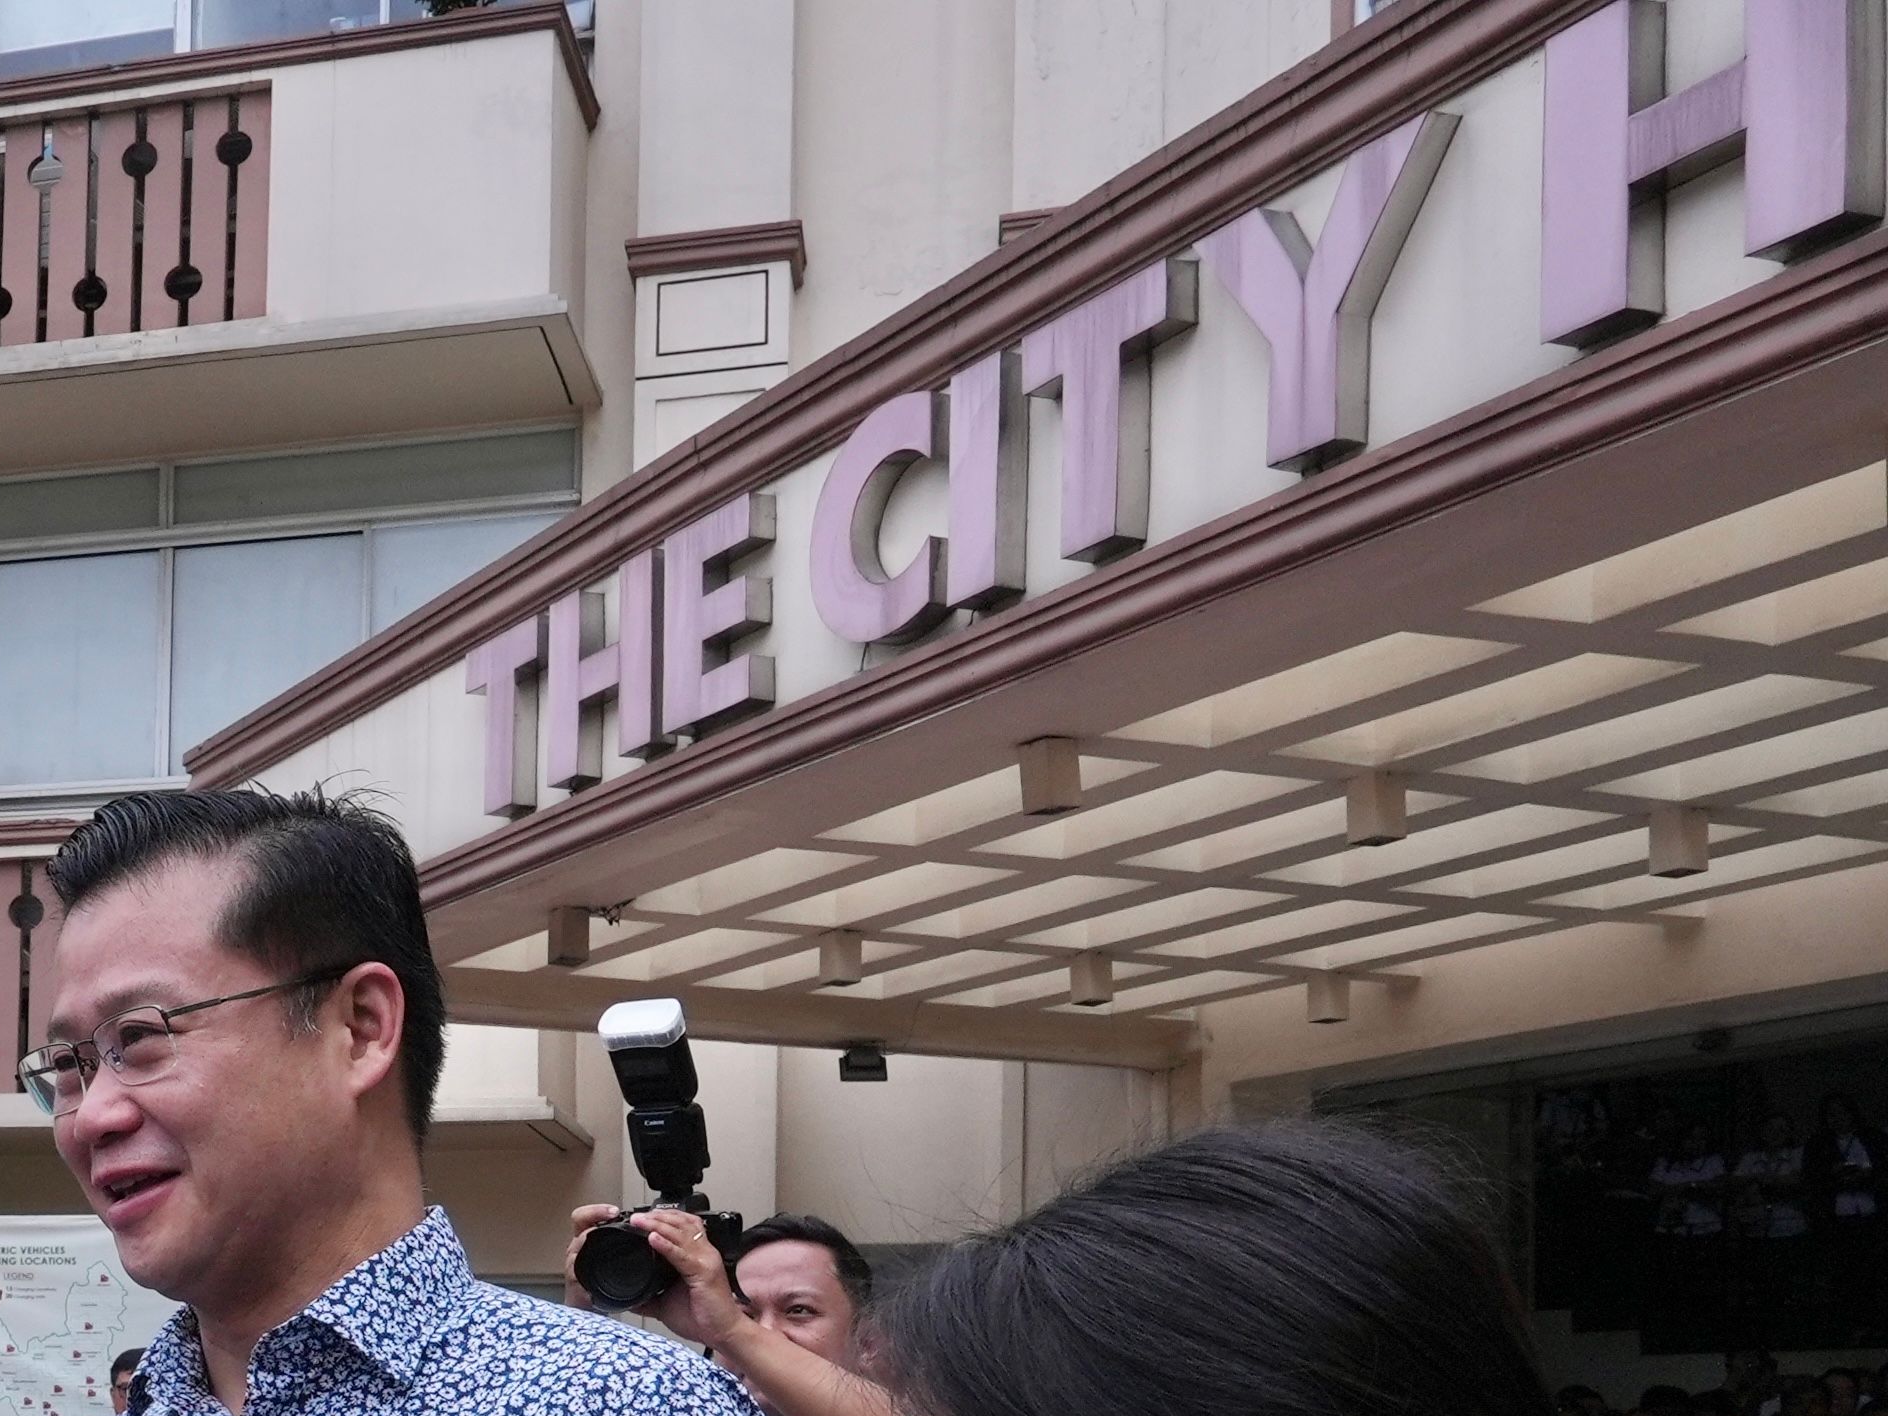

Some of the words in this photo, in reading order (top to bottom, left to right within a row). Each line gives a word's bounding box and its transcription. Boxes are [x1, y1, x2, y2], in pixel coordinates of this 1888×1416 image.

[466, 490, 776, 820] THE
[809, 110, 1462, 648] CITY
[20, 1246, 66, 1256] VEHICLES
[20, 1257, 77, 1266] LOCATIONS
